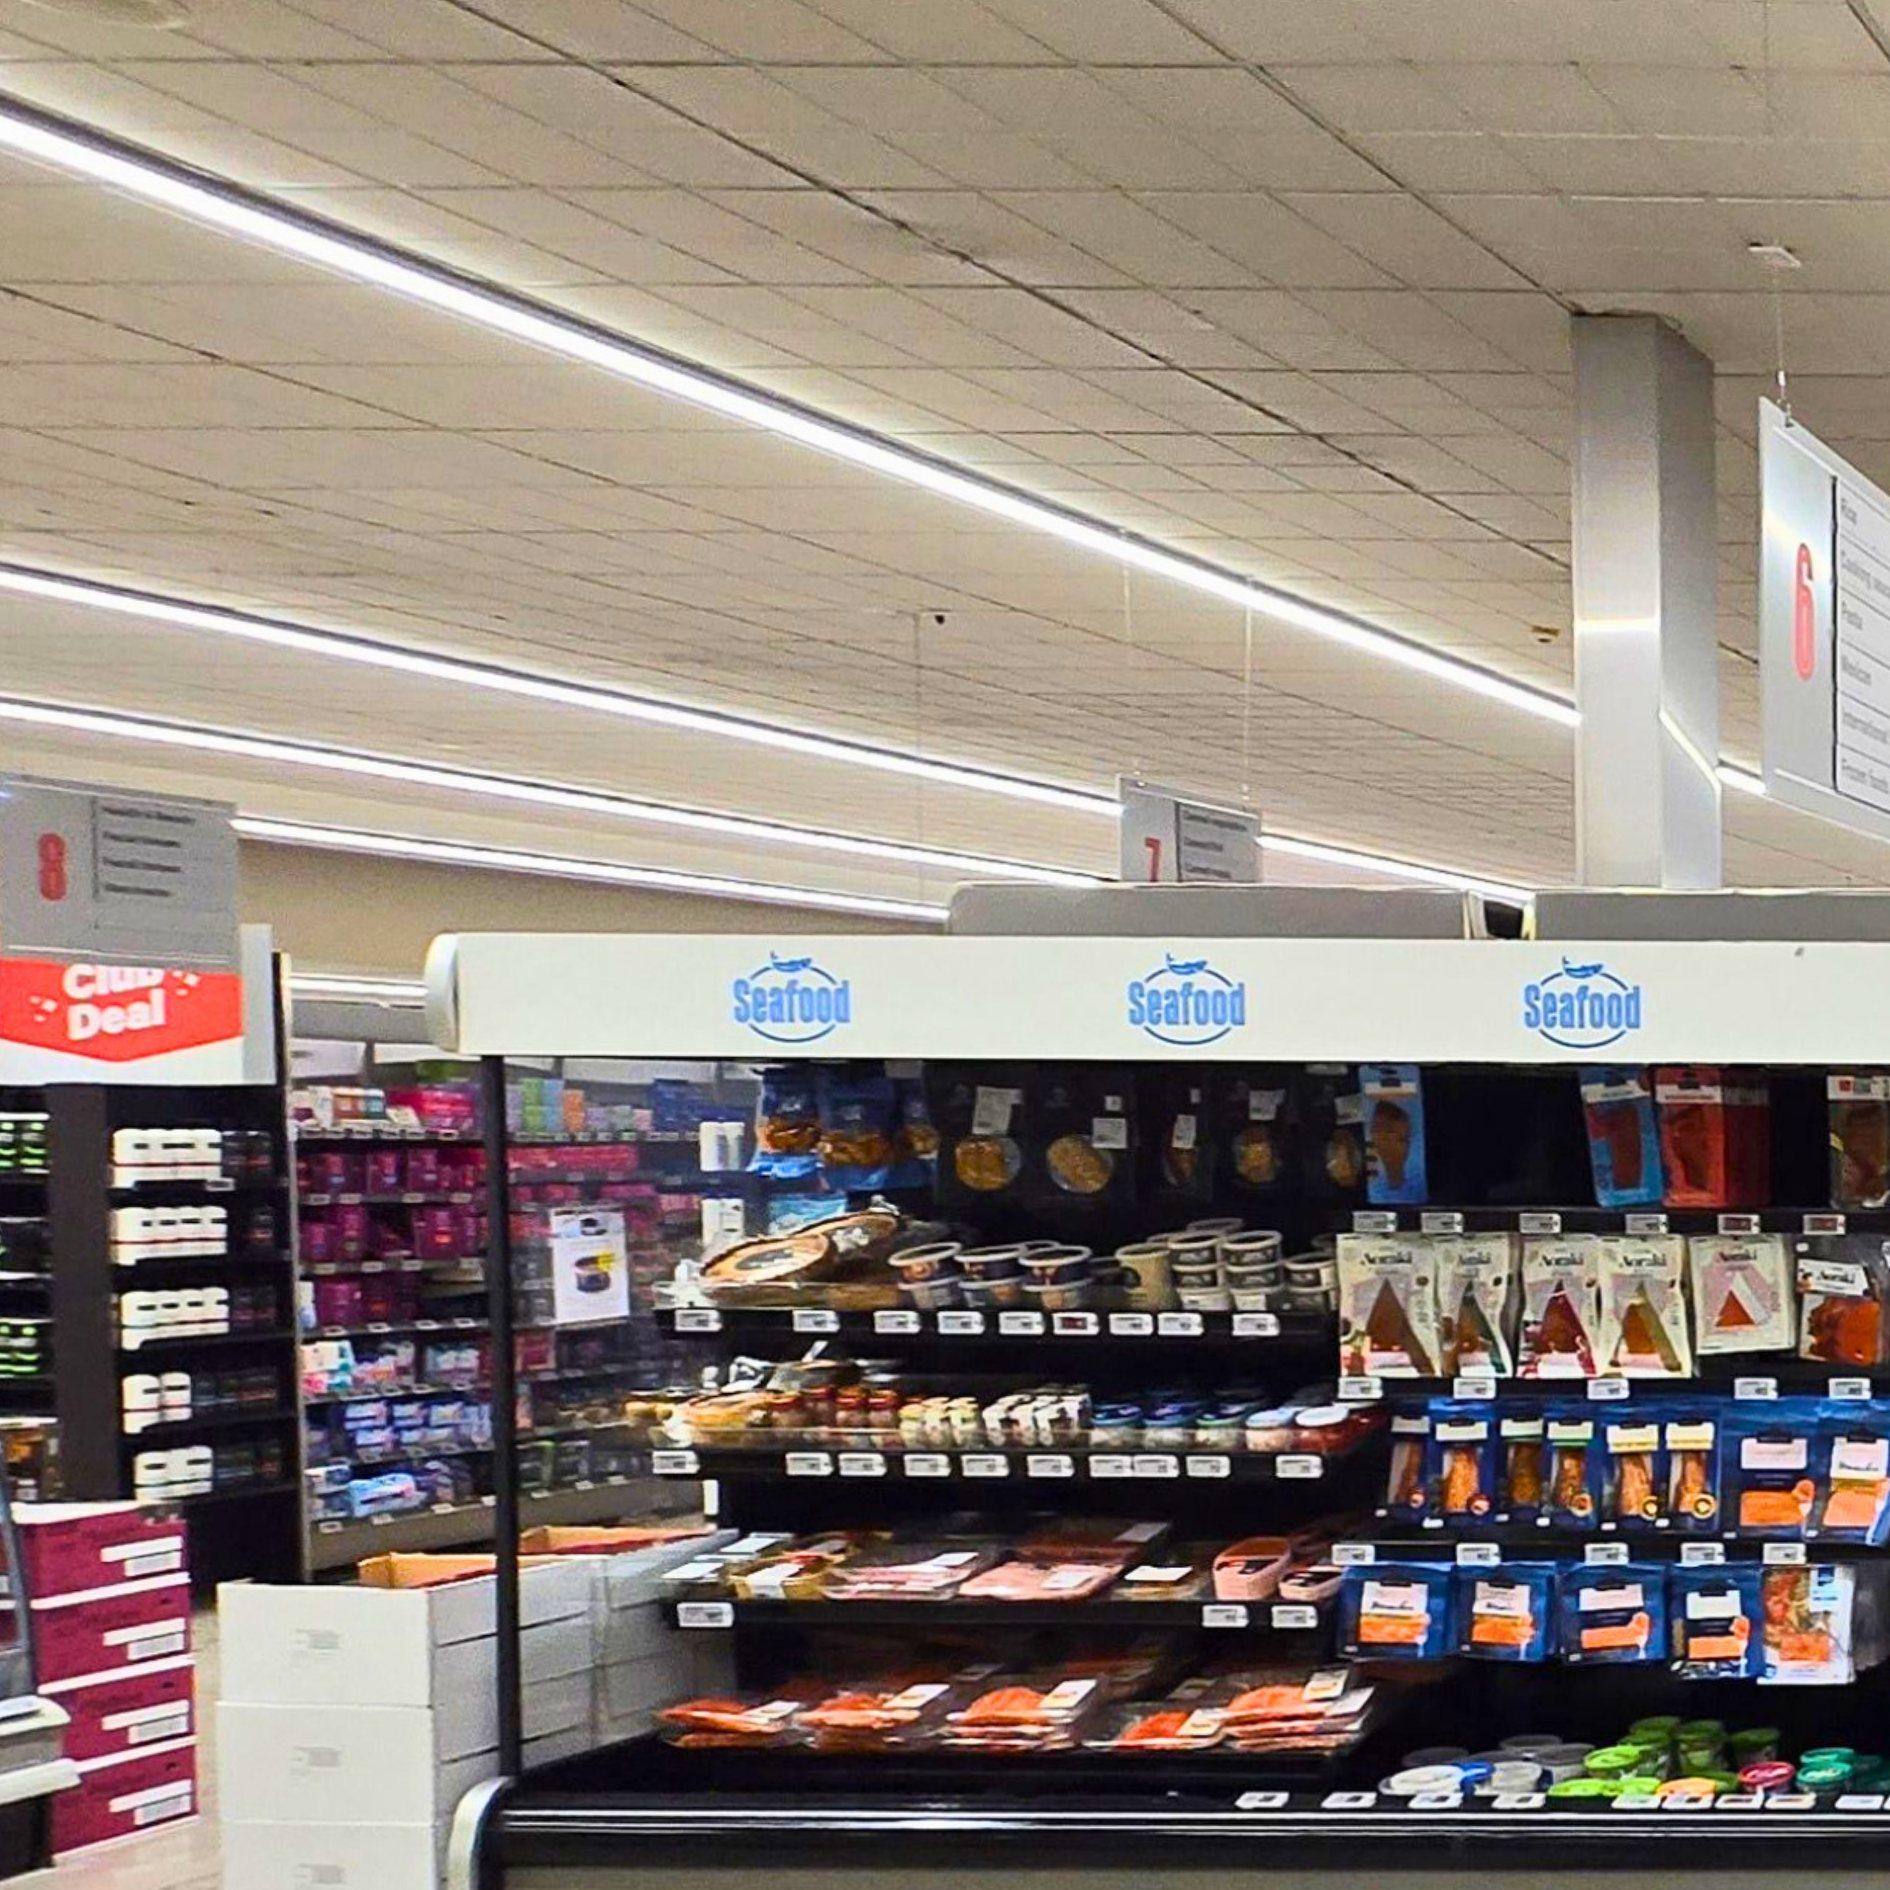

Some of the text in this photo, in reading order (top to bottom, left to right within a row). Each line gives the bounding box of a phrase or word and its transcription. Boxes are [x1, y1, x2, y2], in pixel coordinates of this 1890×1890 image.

[1793, 543, 1815, 680] 6
[39, 833, 67, 900] 8
[1144, 836, 1160, 882] 7
[67, 987, 166, 1041] Deal
[733, 979, 850, 1024] Seafood
[1128, 981, 1245, 1026] Seafood
[1524, 984, 1640, 1029] Seafood
